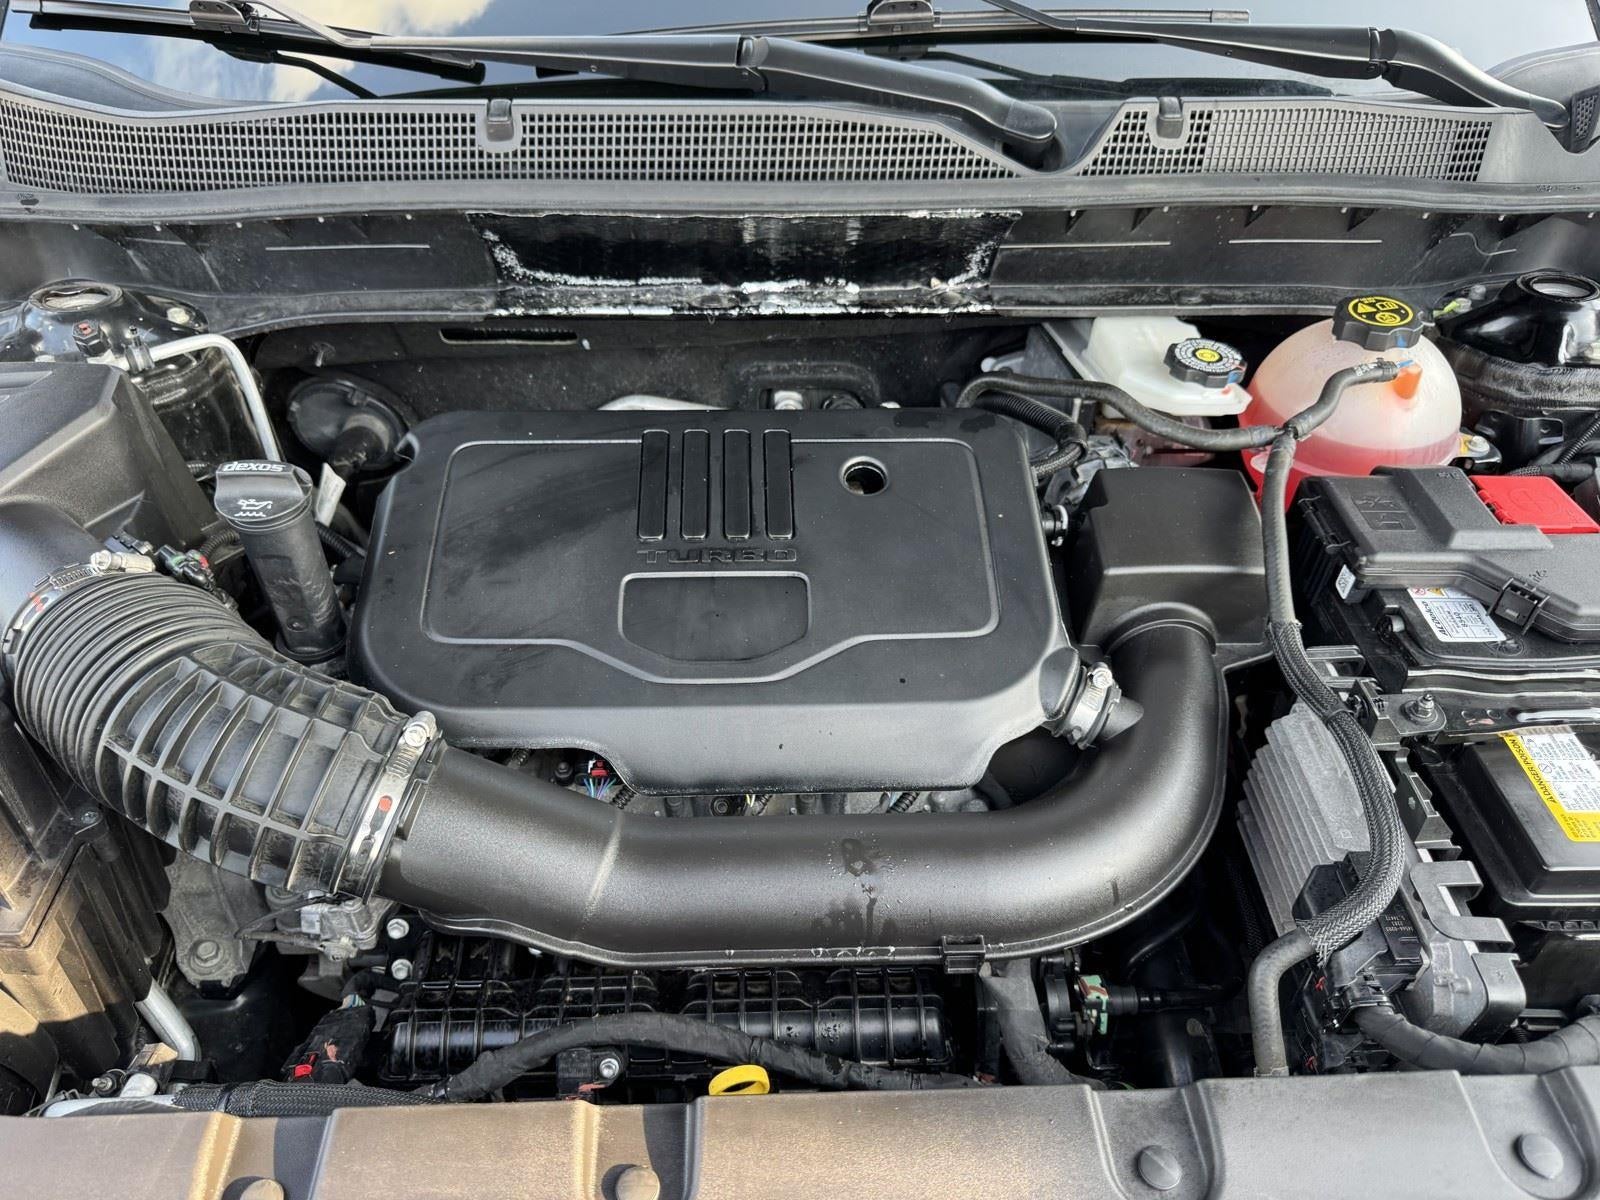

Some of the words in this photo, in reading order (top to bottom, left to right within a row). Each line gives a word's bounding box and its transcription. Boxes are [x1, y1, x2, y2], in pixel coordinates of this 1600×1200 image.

[222, 461, 287, 472] dexos
[636, 549, 798, 564] TURBO
[1508, 737, 1532, 767] POISON
[1527, 765, 1552, 797] DANGER
